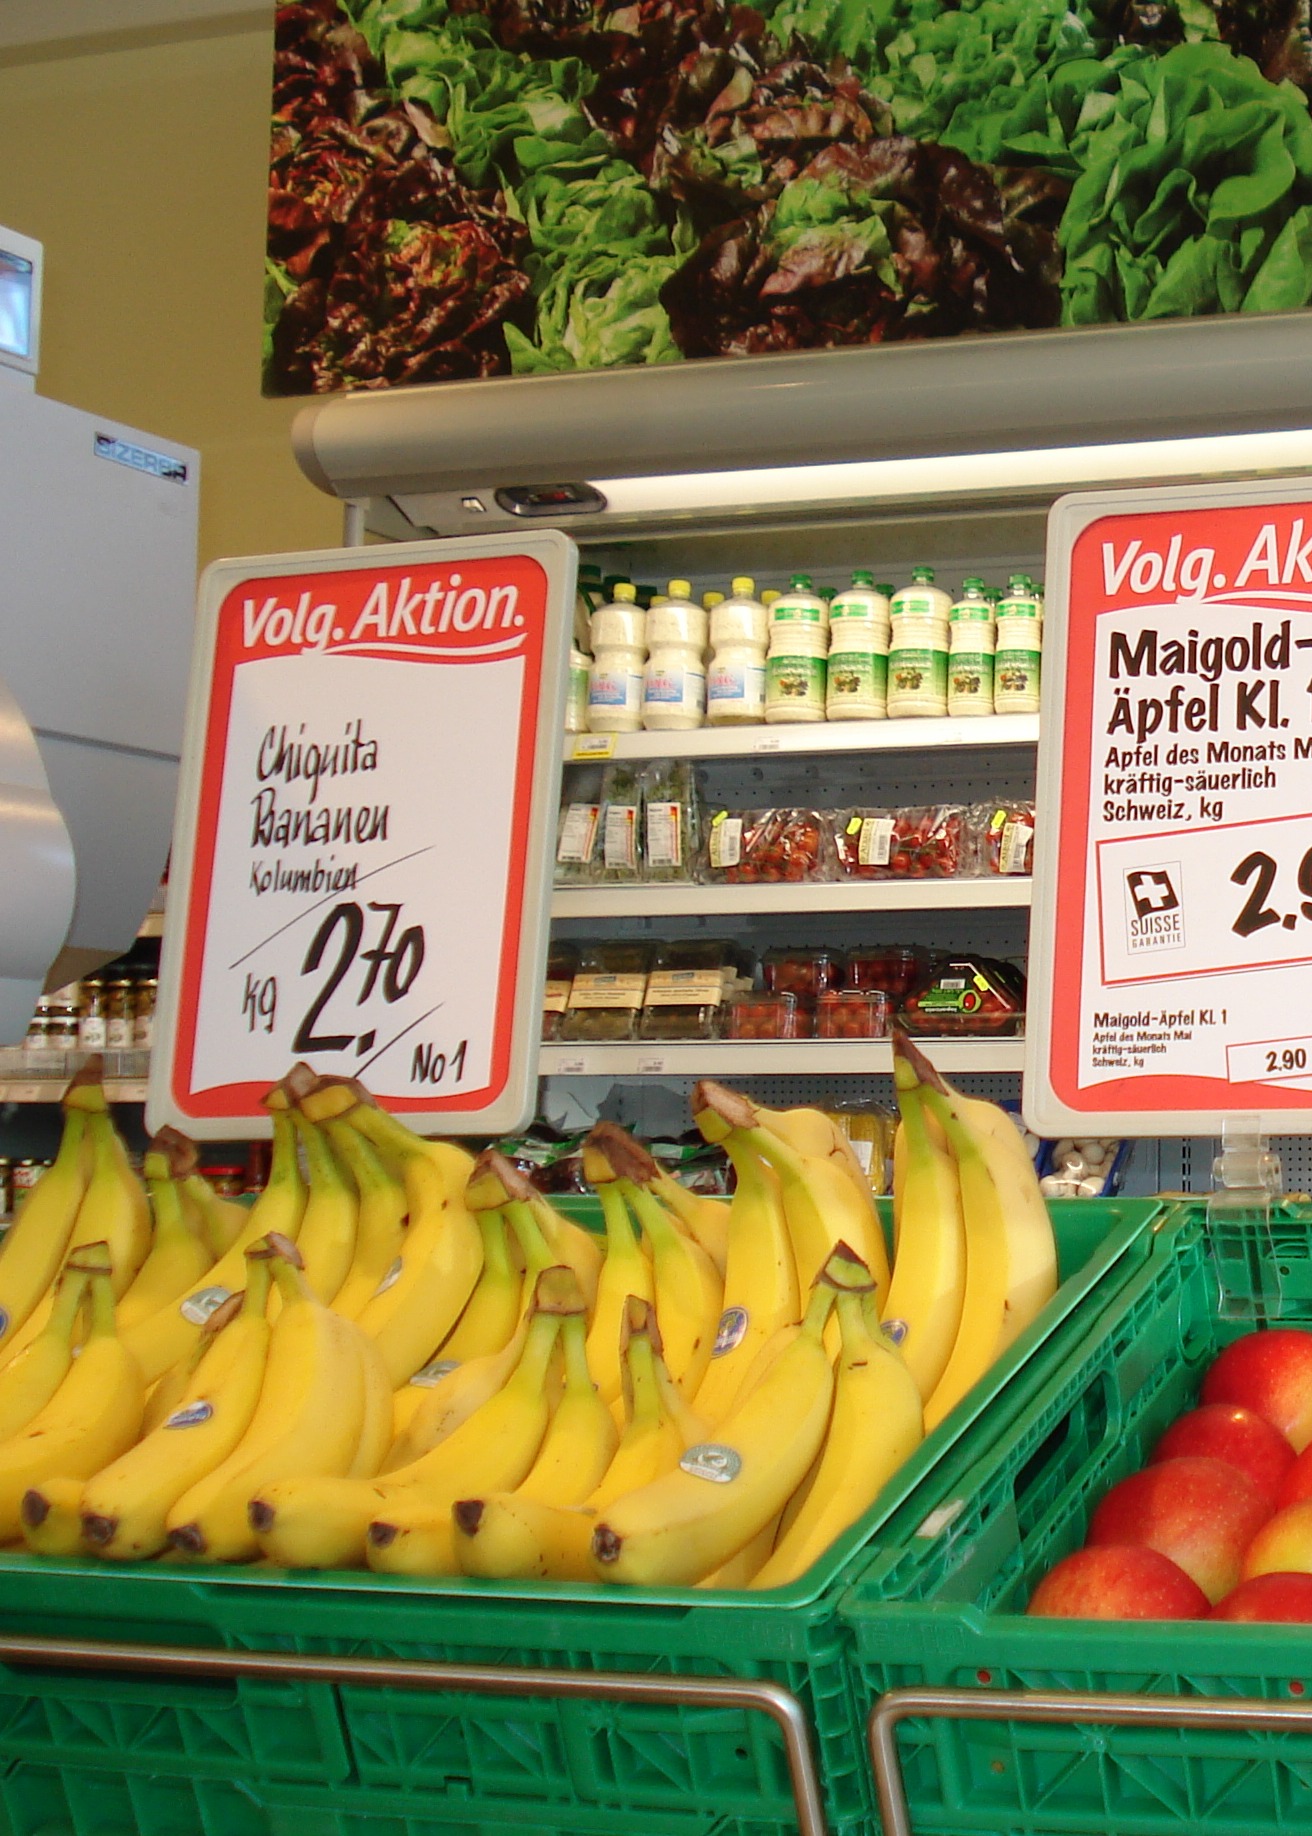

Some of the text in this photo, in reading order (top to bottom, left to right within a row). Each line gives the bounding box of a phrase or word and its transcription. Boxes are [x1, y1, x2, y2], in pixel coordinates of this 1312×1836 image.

[1101, 533, 1225, 604] Volg.
[243, 574, 525, 654] Volg. Aktion.
[1106, 683, 1219, 743] Äpfel
[1236, 679, 1290, 730] Kl.
[256, 719, 378, 799] Chiquita
[1105, 742, 1158, 768] Apfel
[1166, 743, 1199, 766] des
[1206, 741, 1286, 764] Monats
[1104, 766, 1276, 796] kräftig-säuerlich
[250, 787, 390, 848] Bananen
[1103, 797, 1223, 823] Schweiz, kg
[249, 854, 358, 896] Kolumbien
[1131, 914, 1180, 936] SUISSE
[1132, 933, 1182, 948] GARANTIE
[292, 901, 426, 1057] 2.70
[242, 972, 277, 1034] kg
[1093, 1010, 1195, 1029] Maigold-Äpfel
[1221, 1009, 1227, 1024] 1
[1092, 1044, 1167, 1056] kräftig-säuerlich
[1093, 1030, 1192, 1043] Apfel des Monats Mai
[1133, 1056, 1144, 1068] kg
[1265, 1047, 1307, 1073] 2.90
